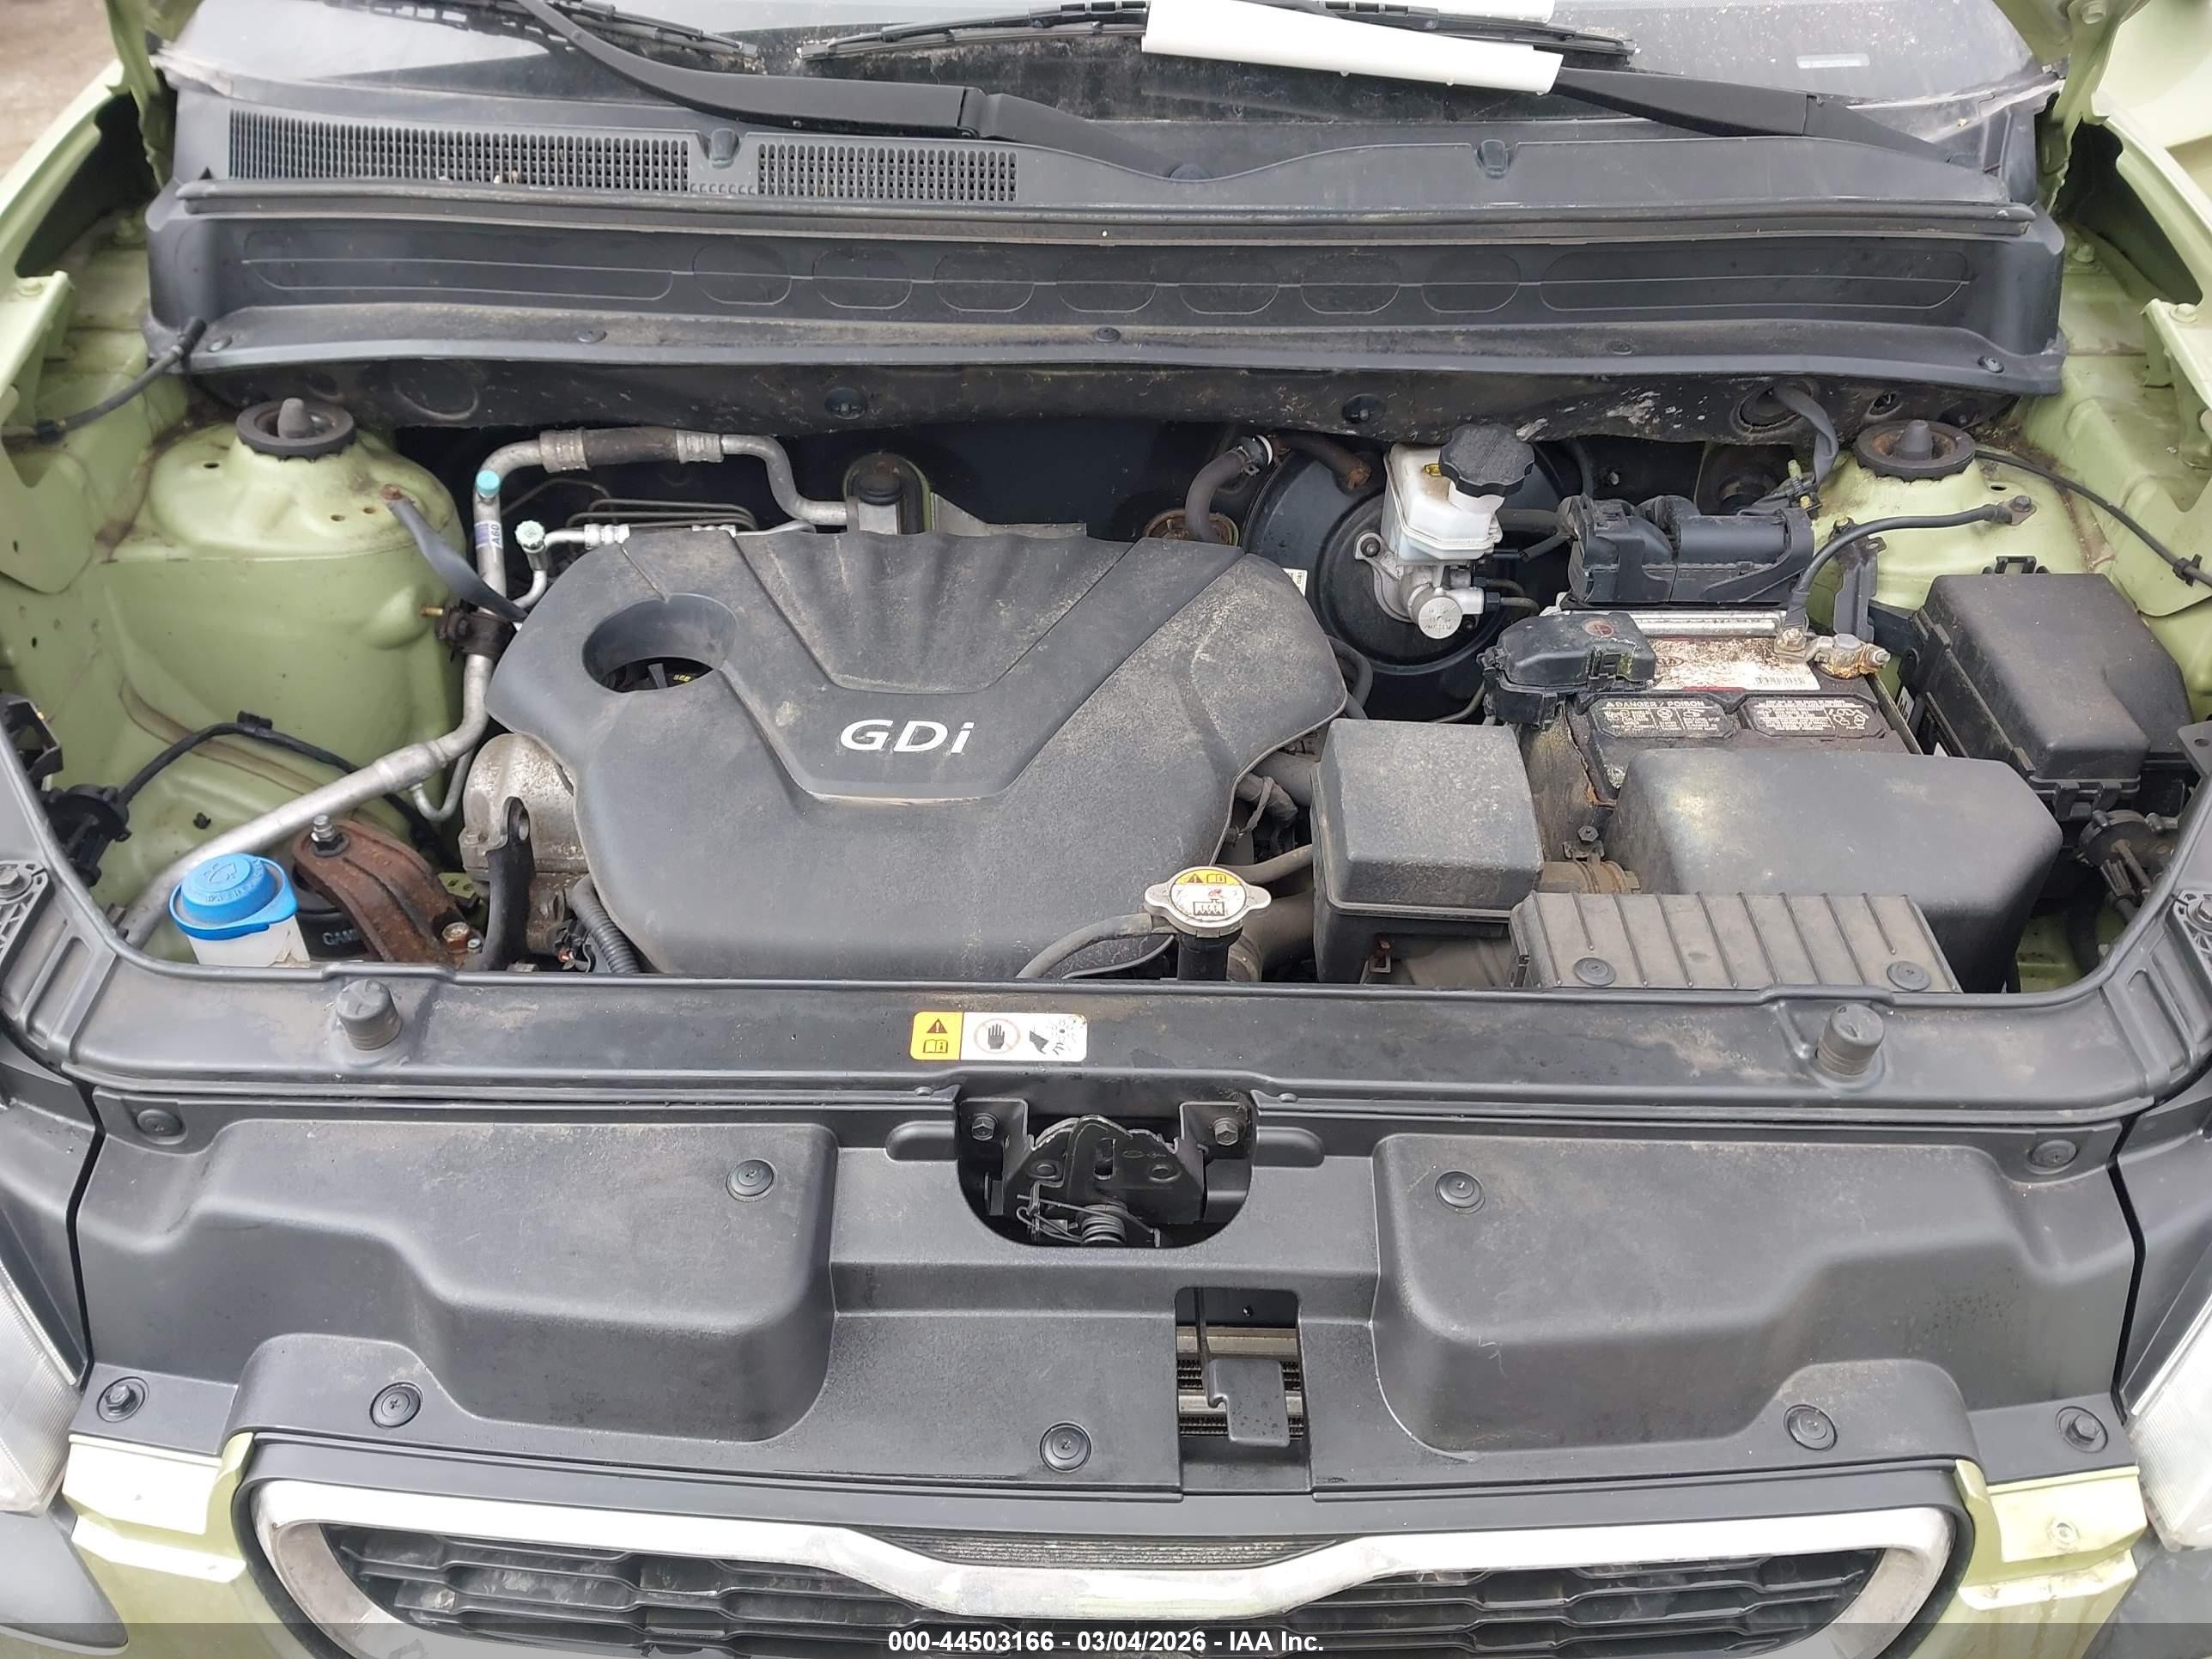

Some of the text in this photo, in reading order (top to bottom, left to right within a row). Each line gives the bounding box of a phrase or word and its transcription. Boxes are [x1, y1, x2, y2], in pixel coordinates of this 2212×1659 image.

[490, 524, 500, 544] A60
[1615, 700, 1657, 708] DANGER
[1667, 700, 1705, 708] POISON
[841, 719, 975, 754] GDi
